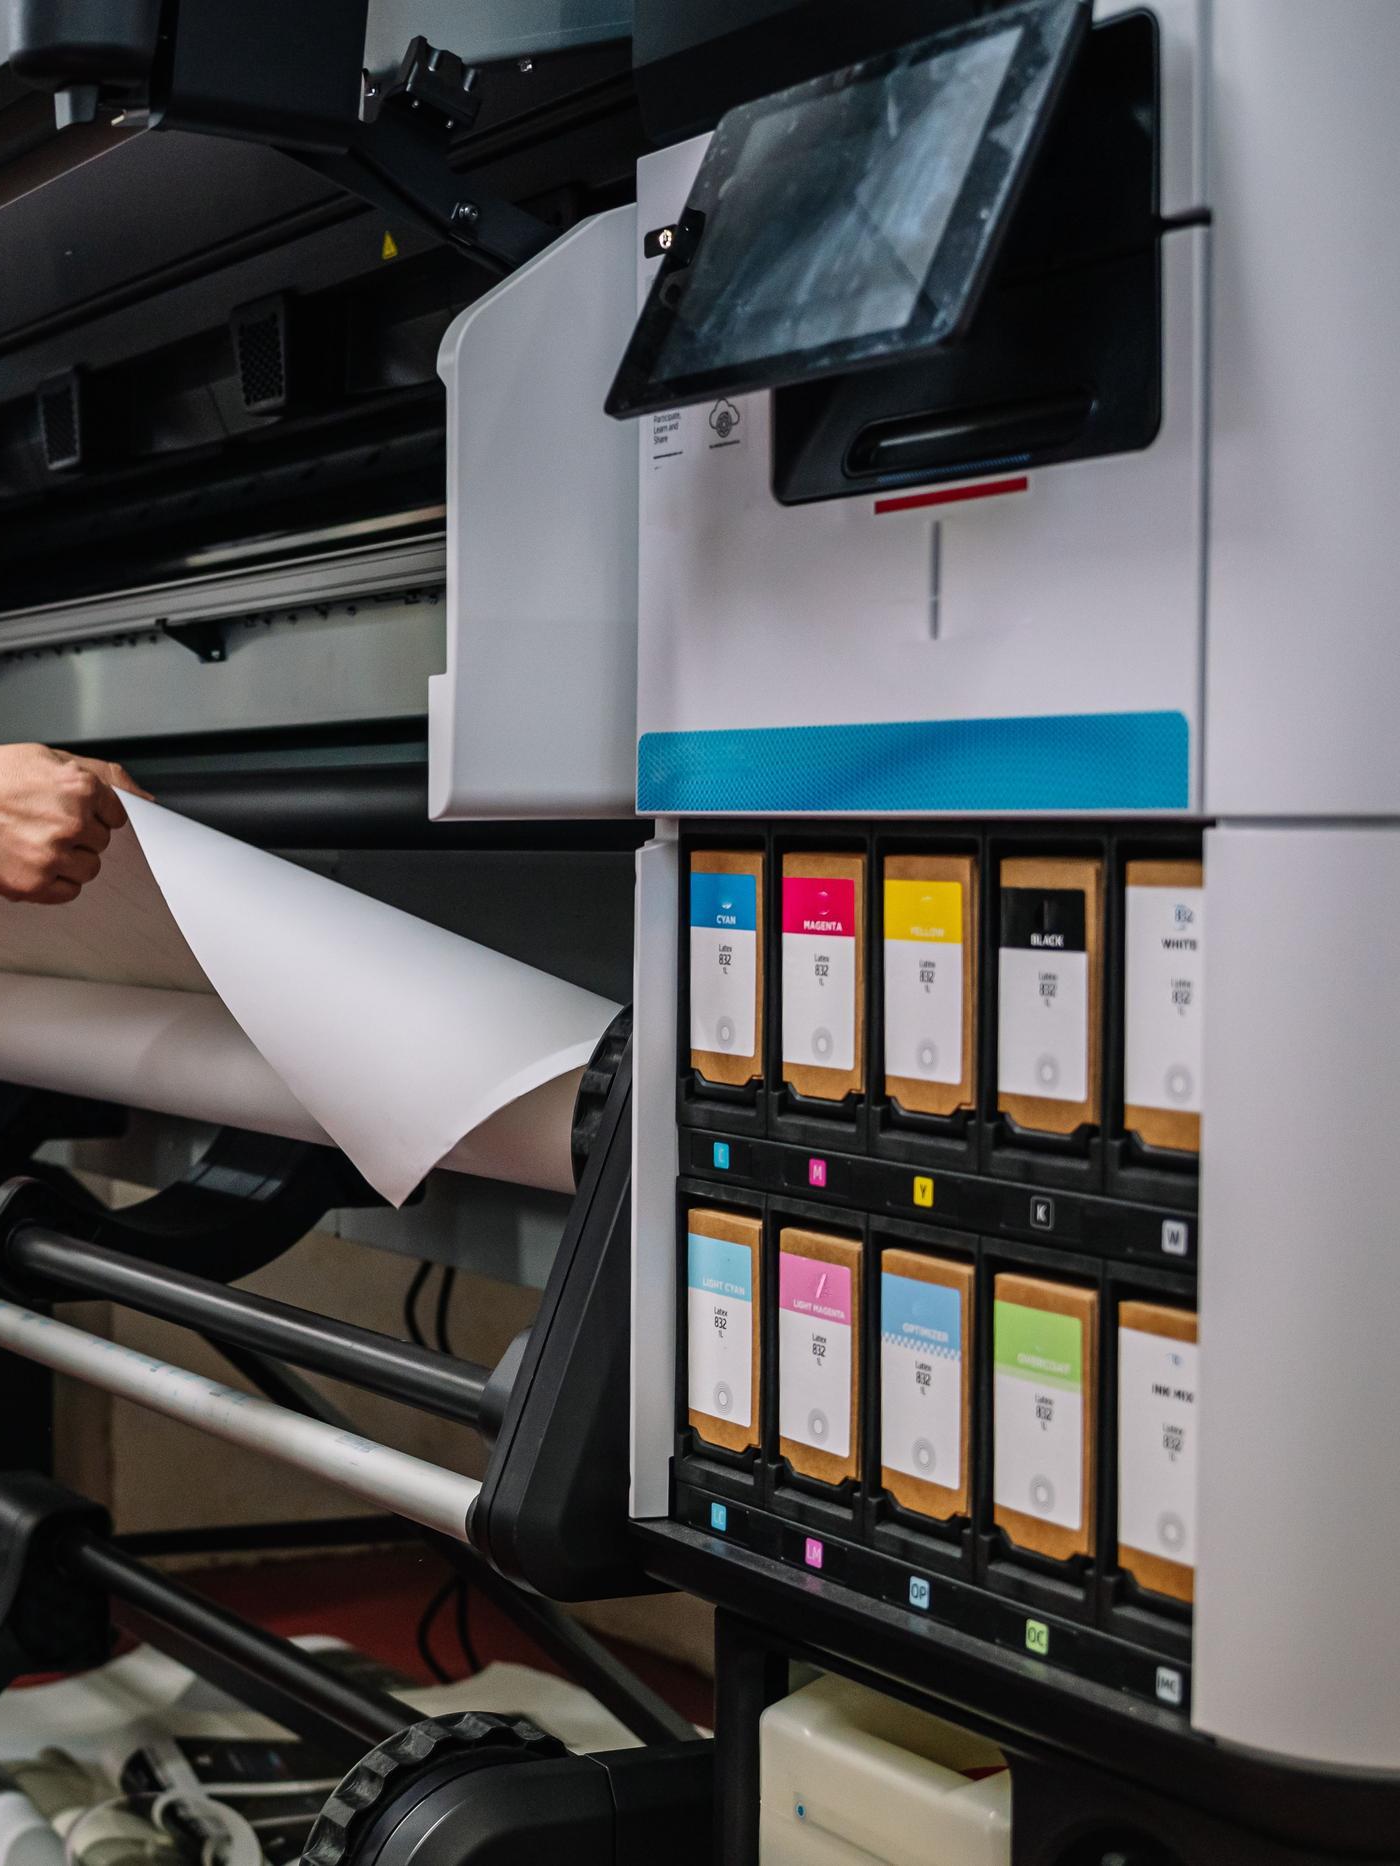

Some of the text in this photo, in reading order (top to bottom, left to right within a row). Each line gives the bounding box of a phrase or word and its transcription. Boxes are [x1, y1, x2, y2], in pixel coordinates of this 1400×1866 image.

[653, 421, 679, 435] Learn and
[653, 435, 668, 445] Share
[716, 914, 737, 925] CYAN
[803, 919, 843, 931] MAGENTA
[1030, 933, 1064, 947] BLACK
[1161, 938, 1198, 951] WHITE
[718, 953, 733, 966] 832
[814, 964, 829, 977] 832
[919, 970, 935, 983] 832
[1039, 983, 1057, 998] 832
[1171, 990, 1192, 1005] 832
[702, 1278, 745, 1295] LIGHT CYAN
[793, 1299, 846, 1320] LIGHT MAGENTA
[714, 1316, 727, 1330] 832
[902, 1323, 949, 1342] OPTIMIZER
[812, 1343, 826, 1358] 832
[916, 1370, 932, 1386] 832
[1035, 1405, 1054, 1422] 832
[1162, 1434, 1184, 1452] 832
[910, 1583, 927, 1600] OP
[1027, 1626, 1046, 1647] OC
